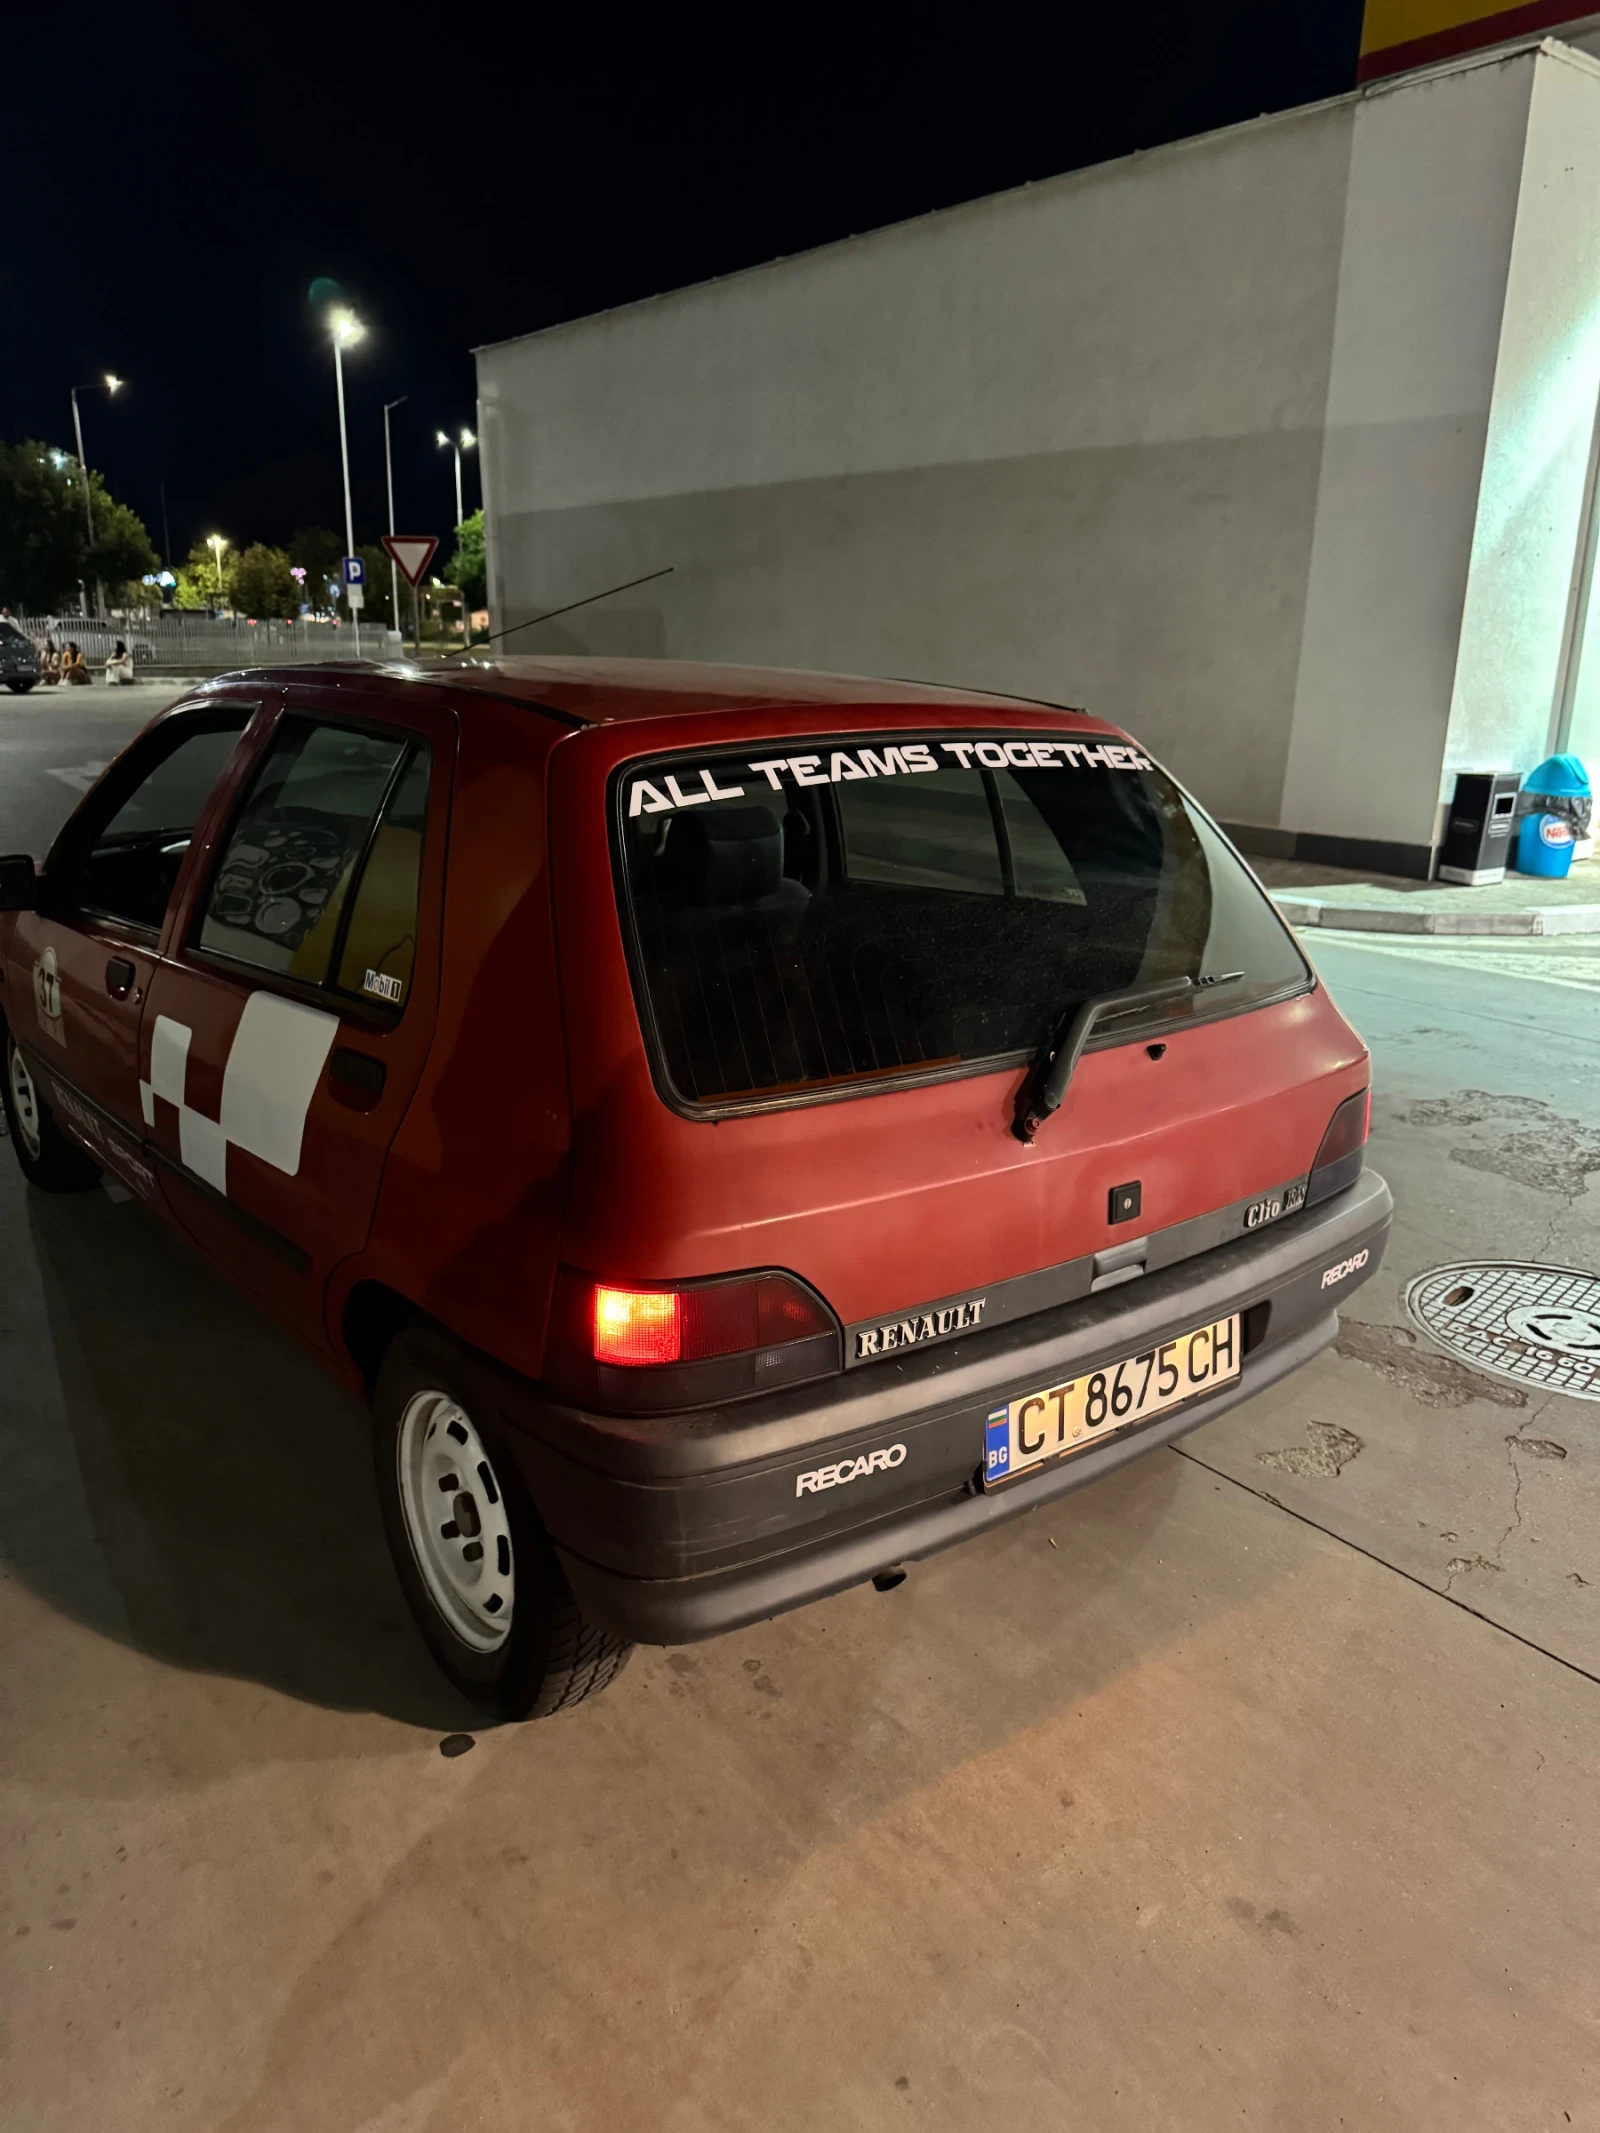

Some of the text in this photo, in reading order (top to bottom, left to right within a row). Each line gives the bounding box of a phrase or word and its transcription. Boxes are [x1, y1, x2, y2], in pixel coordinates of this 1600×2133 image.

[348, 561, 361, 581] P
[629, 742, 1154, 818] ALL TEAMS TOGETHER
[39, 967, 55, 1014] 37
[365, 971, 391, 996] Mobil
[1246, 1199, 1281, 1228] Clio
[1320, 1248, 1370, 1290] RECARO
[856, 1298, 987, 1358] RENAULT
[1018, 1318, 1233, 1455] CT 8675 CH
[795, 1443, 908, 1498] RECARO
[988, 1446, 1008, 1468] BG
